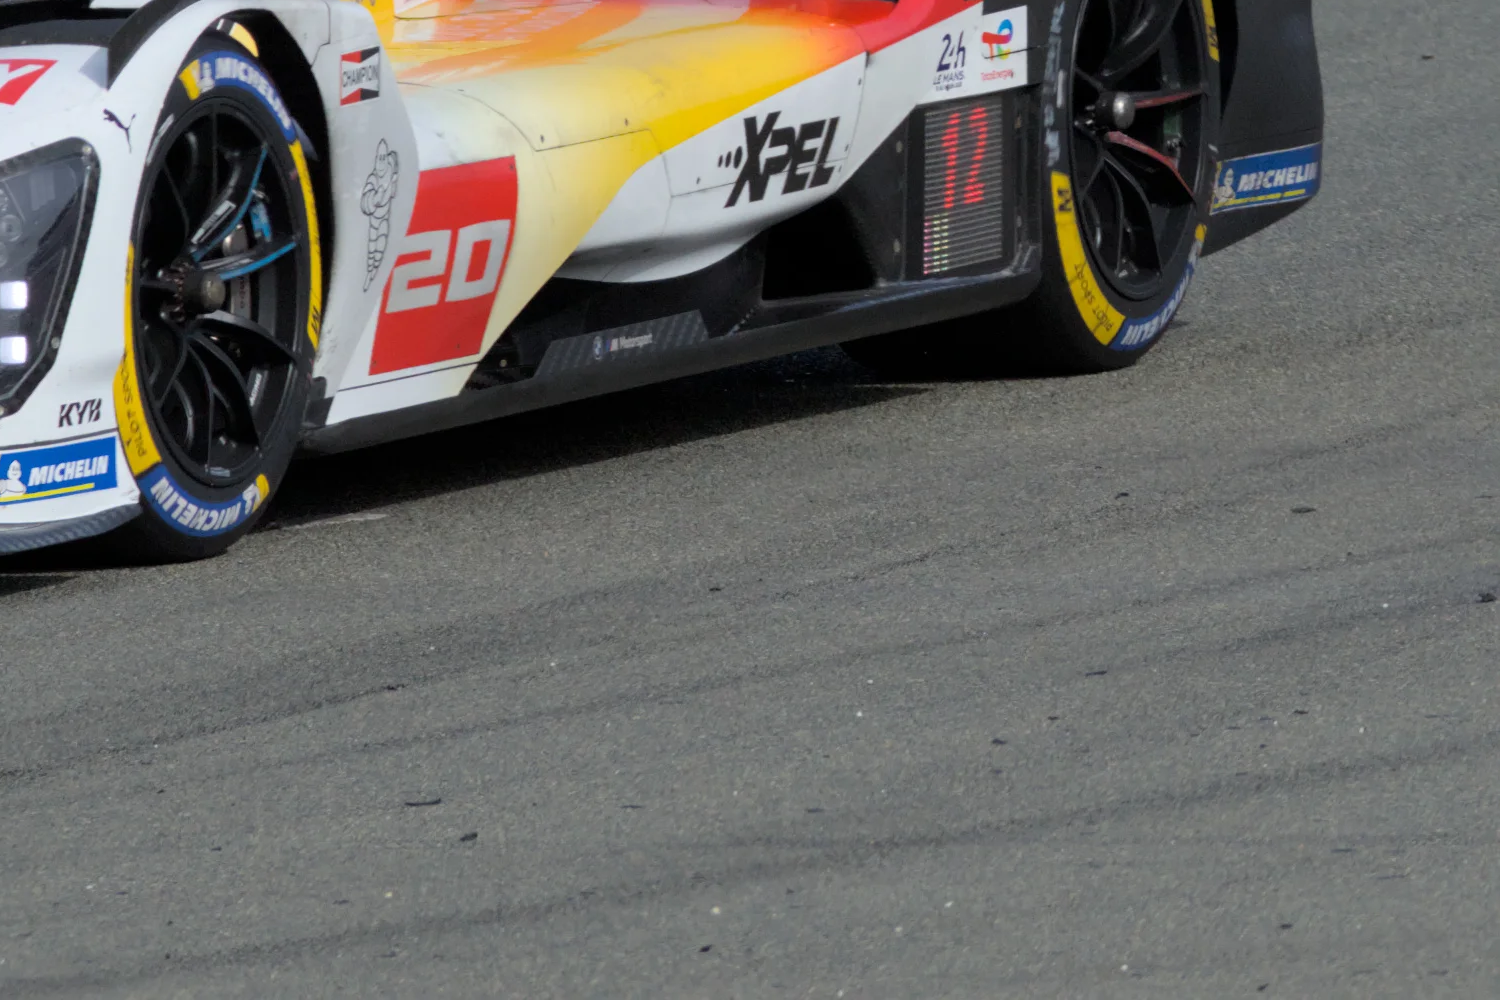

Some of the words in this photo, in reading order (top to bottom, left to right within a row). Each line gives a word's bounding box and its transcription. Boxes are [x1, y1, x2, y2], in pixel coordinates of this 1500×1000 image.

[214, 56, 292, 130] MICHELIN
[342, 64, 379, 89] CHAMPION
[723, 109, 841, 208] XPEL
[1236, 161, 1319, 192] MICHELIN
[385, 219, 511, 314] 20
[28, 454, 110, 487] MICHELIN
[150, 476, 242, 531] MICHELIN
